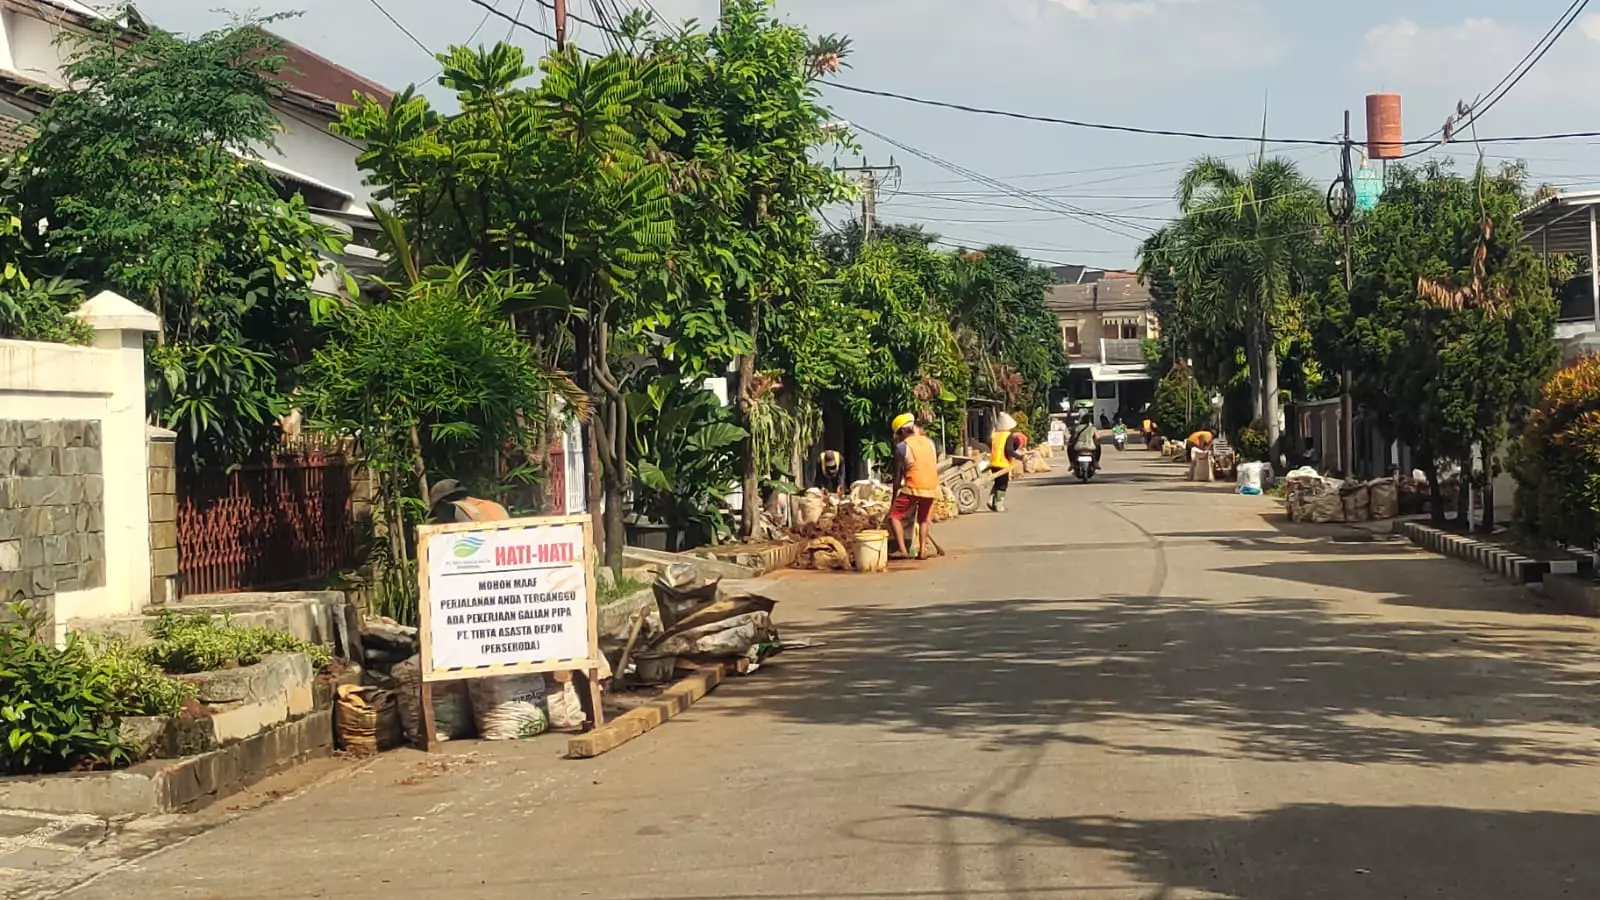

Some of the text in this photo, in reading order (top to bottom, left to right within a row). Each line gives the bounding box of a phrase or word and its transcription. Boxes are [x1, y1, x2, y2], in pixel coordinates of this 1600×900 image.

[495, 542, 574, 566] HATI-HATI
[478, 577, 538, 591] MOHON MAAF
[440, 591, 577, 610] PERJALANAN ANDA TERGANGGU
[447, 607, 572, 625] ADA PEKERJAAN GALIAN PIPA
[457, 623, 564, 641] PT. TIRTA ASASTA DEPOK
[481, 640, 540, 655] (PERSERODA)
